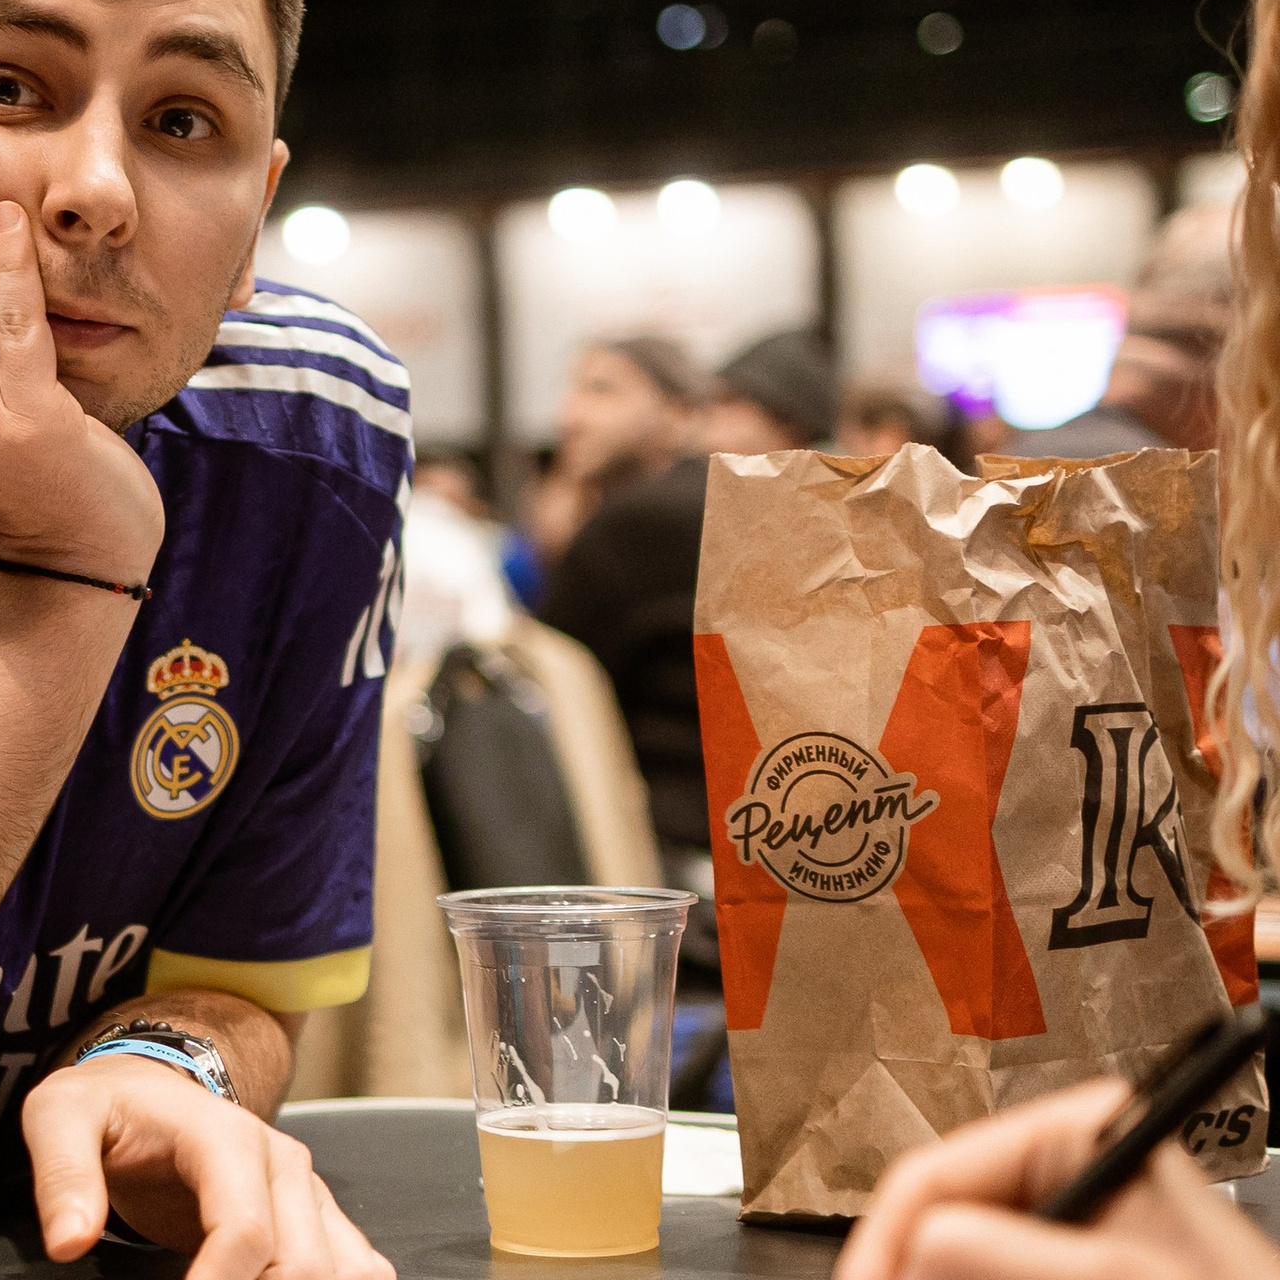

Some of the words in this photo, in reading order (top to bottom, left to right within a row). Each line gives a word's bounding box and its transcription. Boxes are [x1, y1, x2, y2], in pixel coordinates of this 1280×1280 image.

[766, 744, 871, 791] ФИРМЕННЫЙ
[730, 782, 934, 862] Рецепт
[788, 840, 892, 893] ФИРМЕННЫЙ
